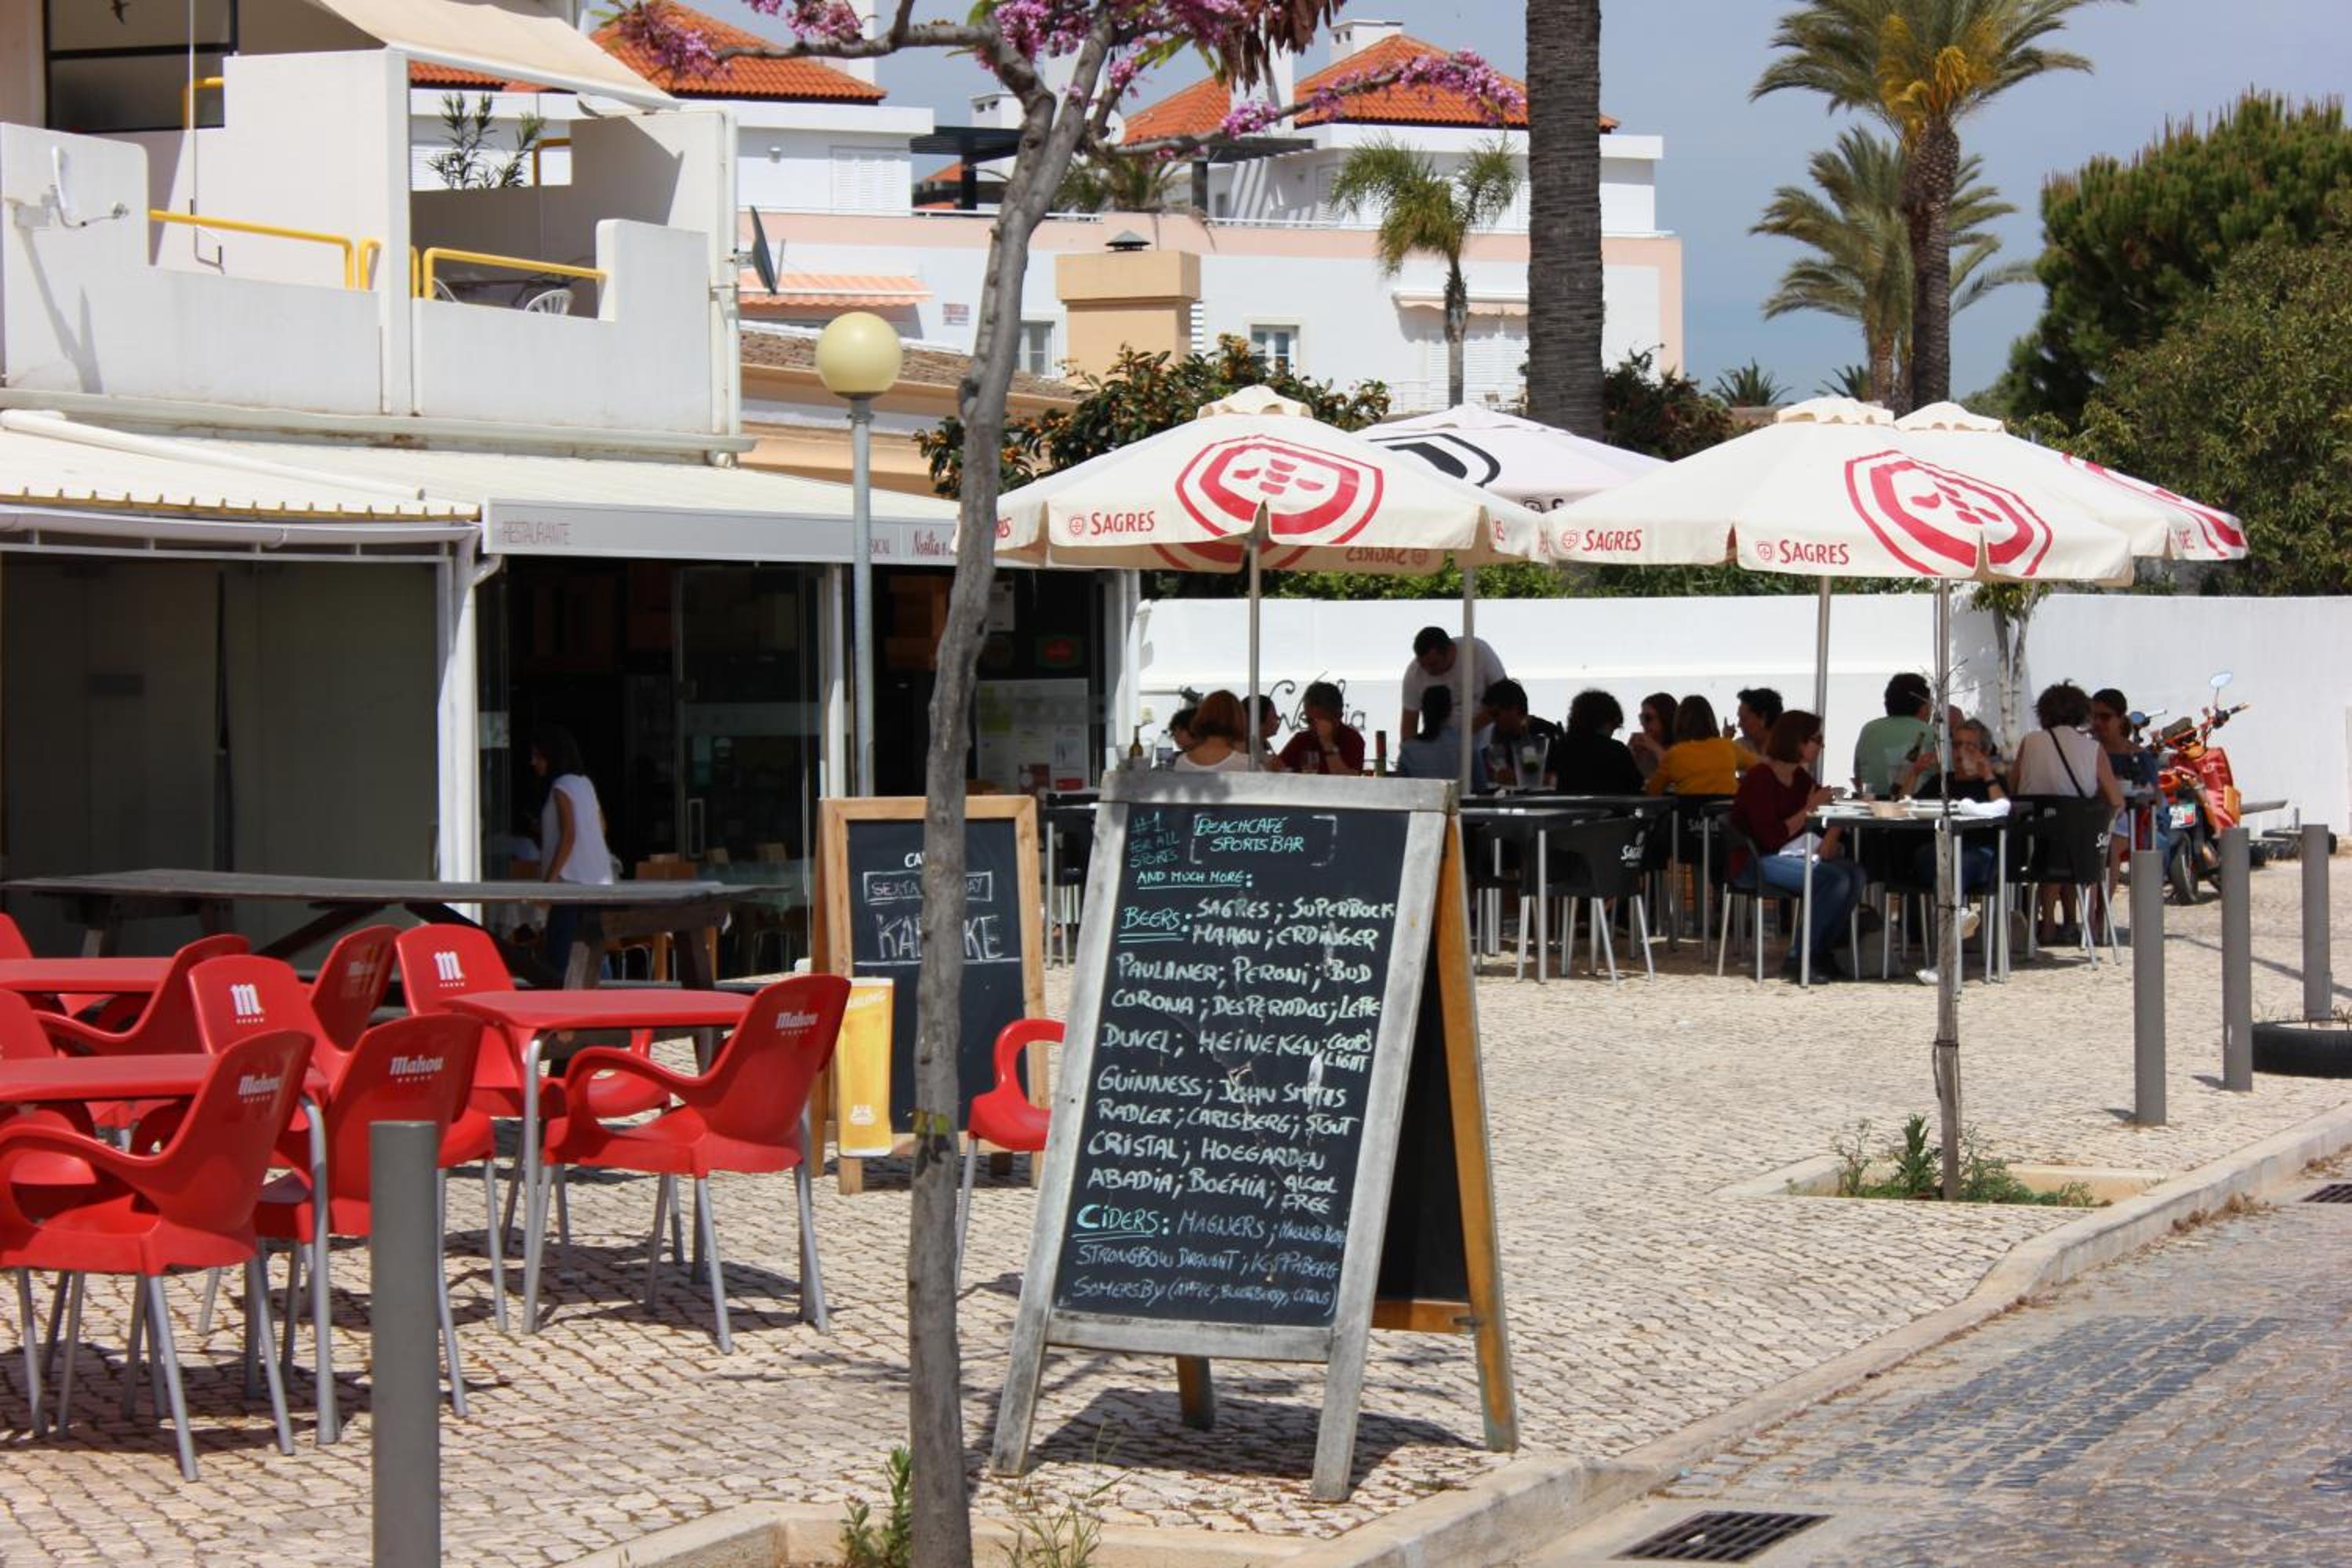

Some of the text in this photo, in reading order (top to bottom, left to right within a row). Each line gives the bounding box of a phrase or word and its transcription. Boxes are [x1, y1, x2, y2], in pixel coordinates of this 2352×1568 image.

[1091, 510, 1155, 535] SAGRES
[1582, 528, 1642, 552] SAGRES
[1780, 539, 1850, 565] SAGRES
[1137, 871, 1165, 884] AND
[1171, 872, 1205, 883] MUCH
[1327, 957, 1373, 984] BUD
[1281, 1193, 1331, 1214] FREE
